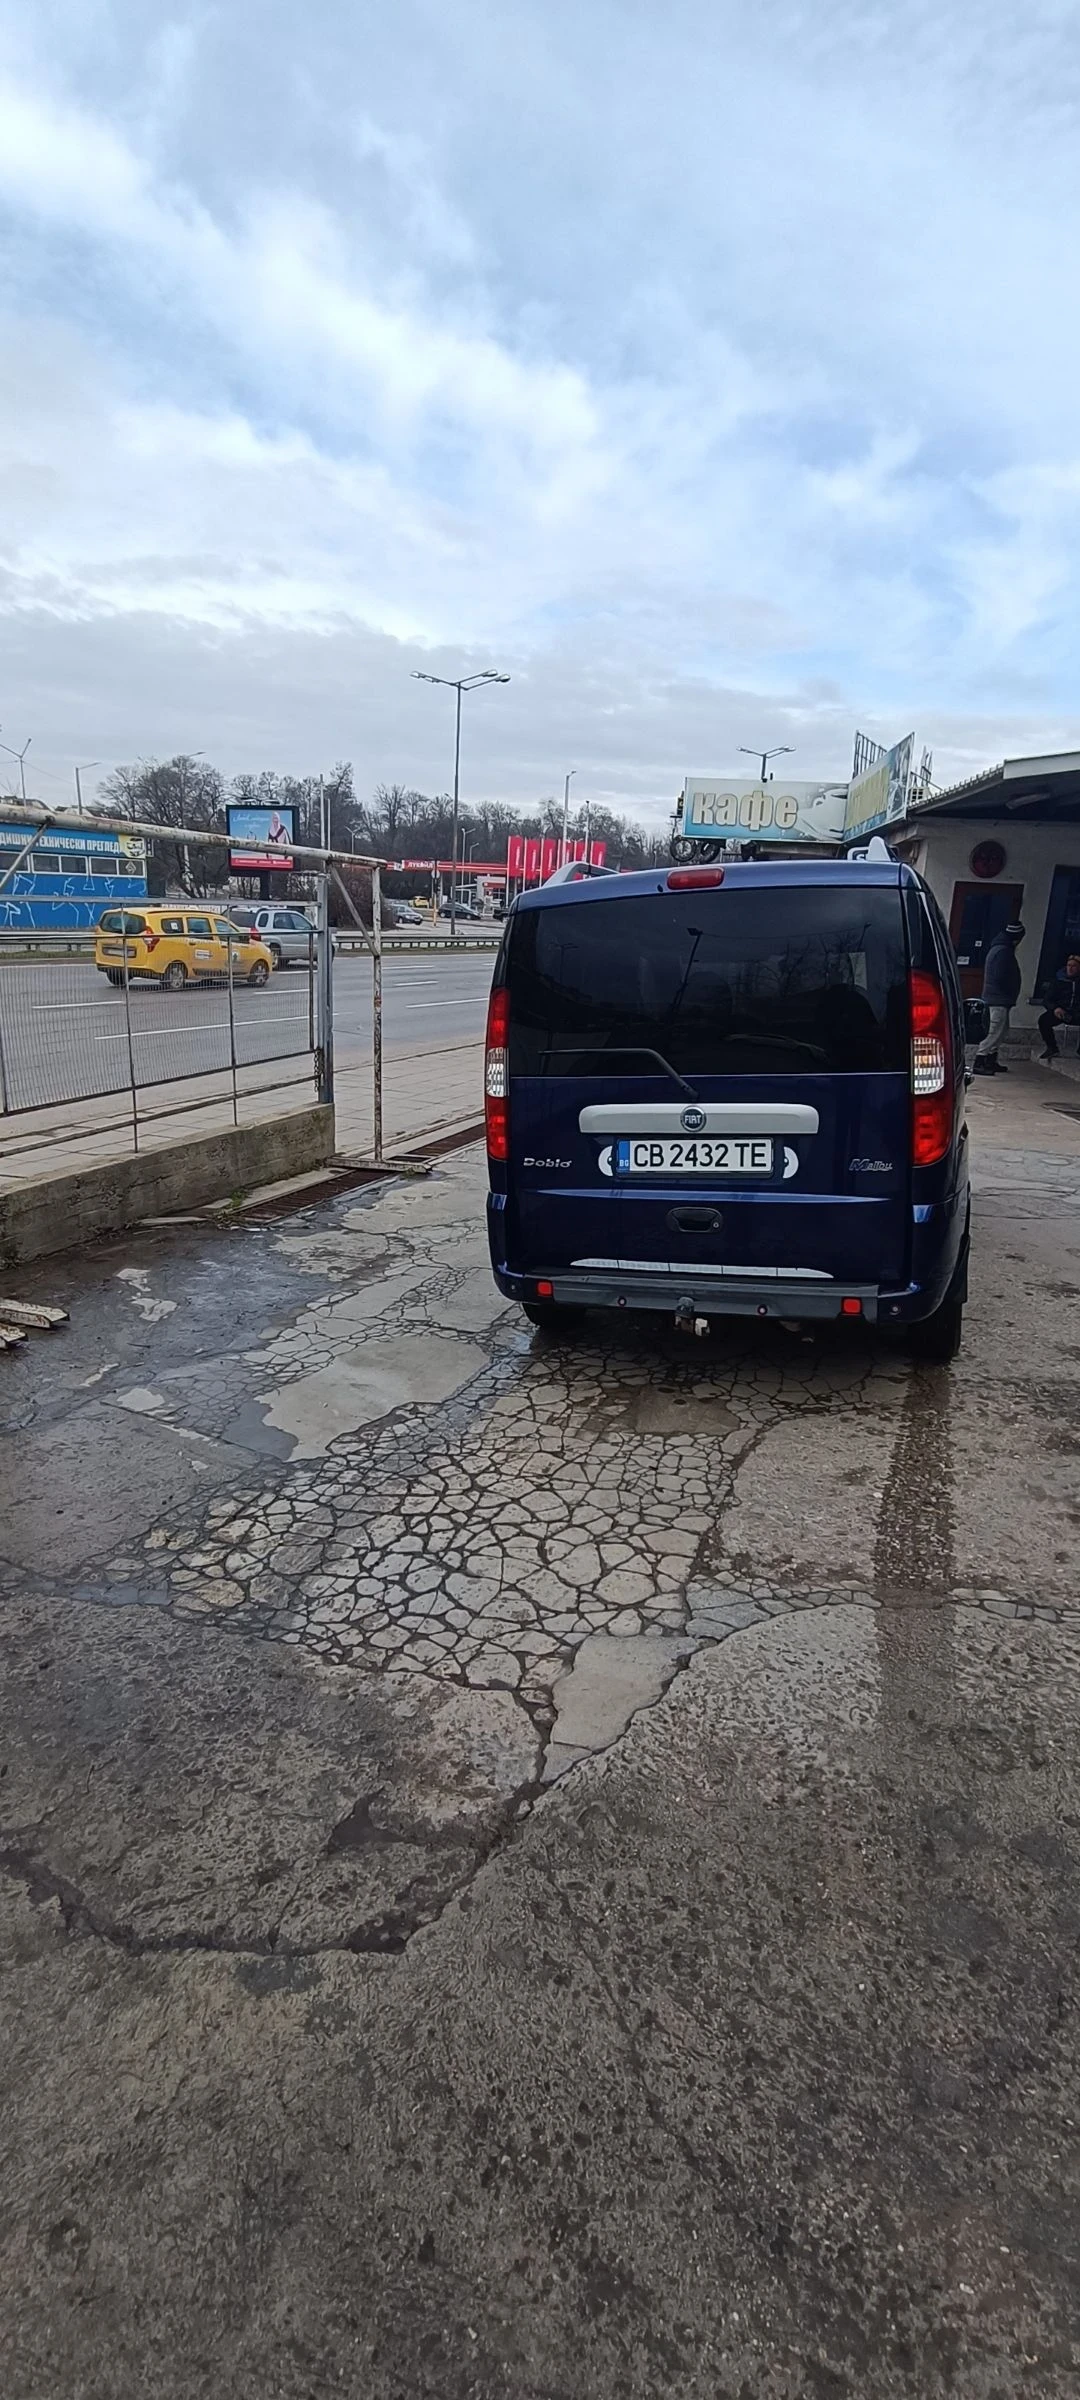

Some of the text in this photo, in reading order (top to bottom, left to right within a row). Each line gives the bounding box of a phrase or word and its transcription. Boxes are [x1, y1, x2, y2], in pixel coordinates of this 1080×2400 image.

[692, 790, 799, 832] кафе
[36, 835, 86, 850] ЕХНИЧЕСКИ
[684, 1115, 702, 1125] FIAT
[619, 1159, 629, 1167] BG
[633, 1143, 767, 1168] CB 2432 TE
